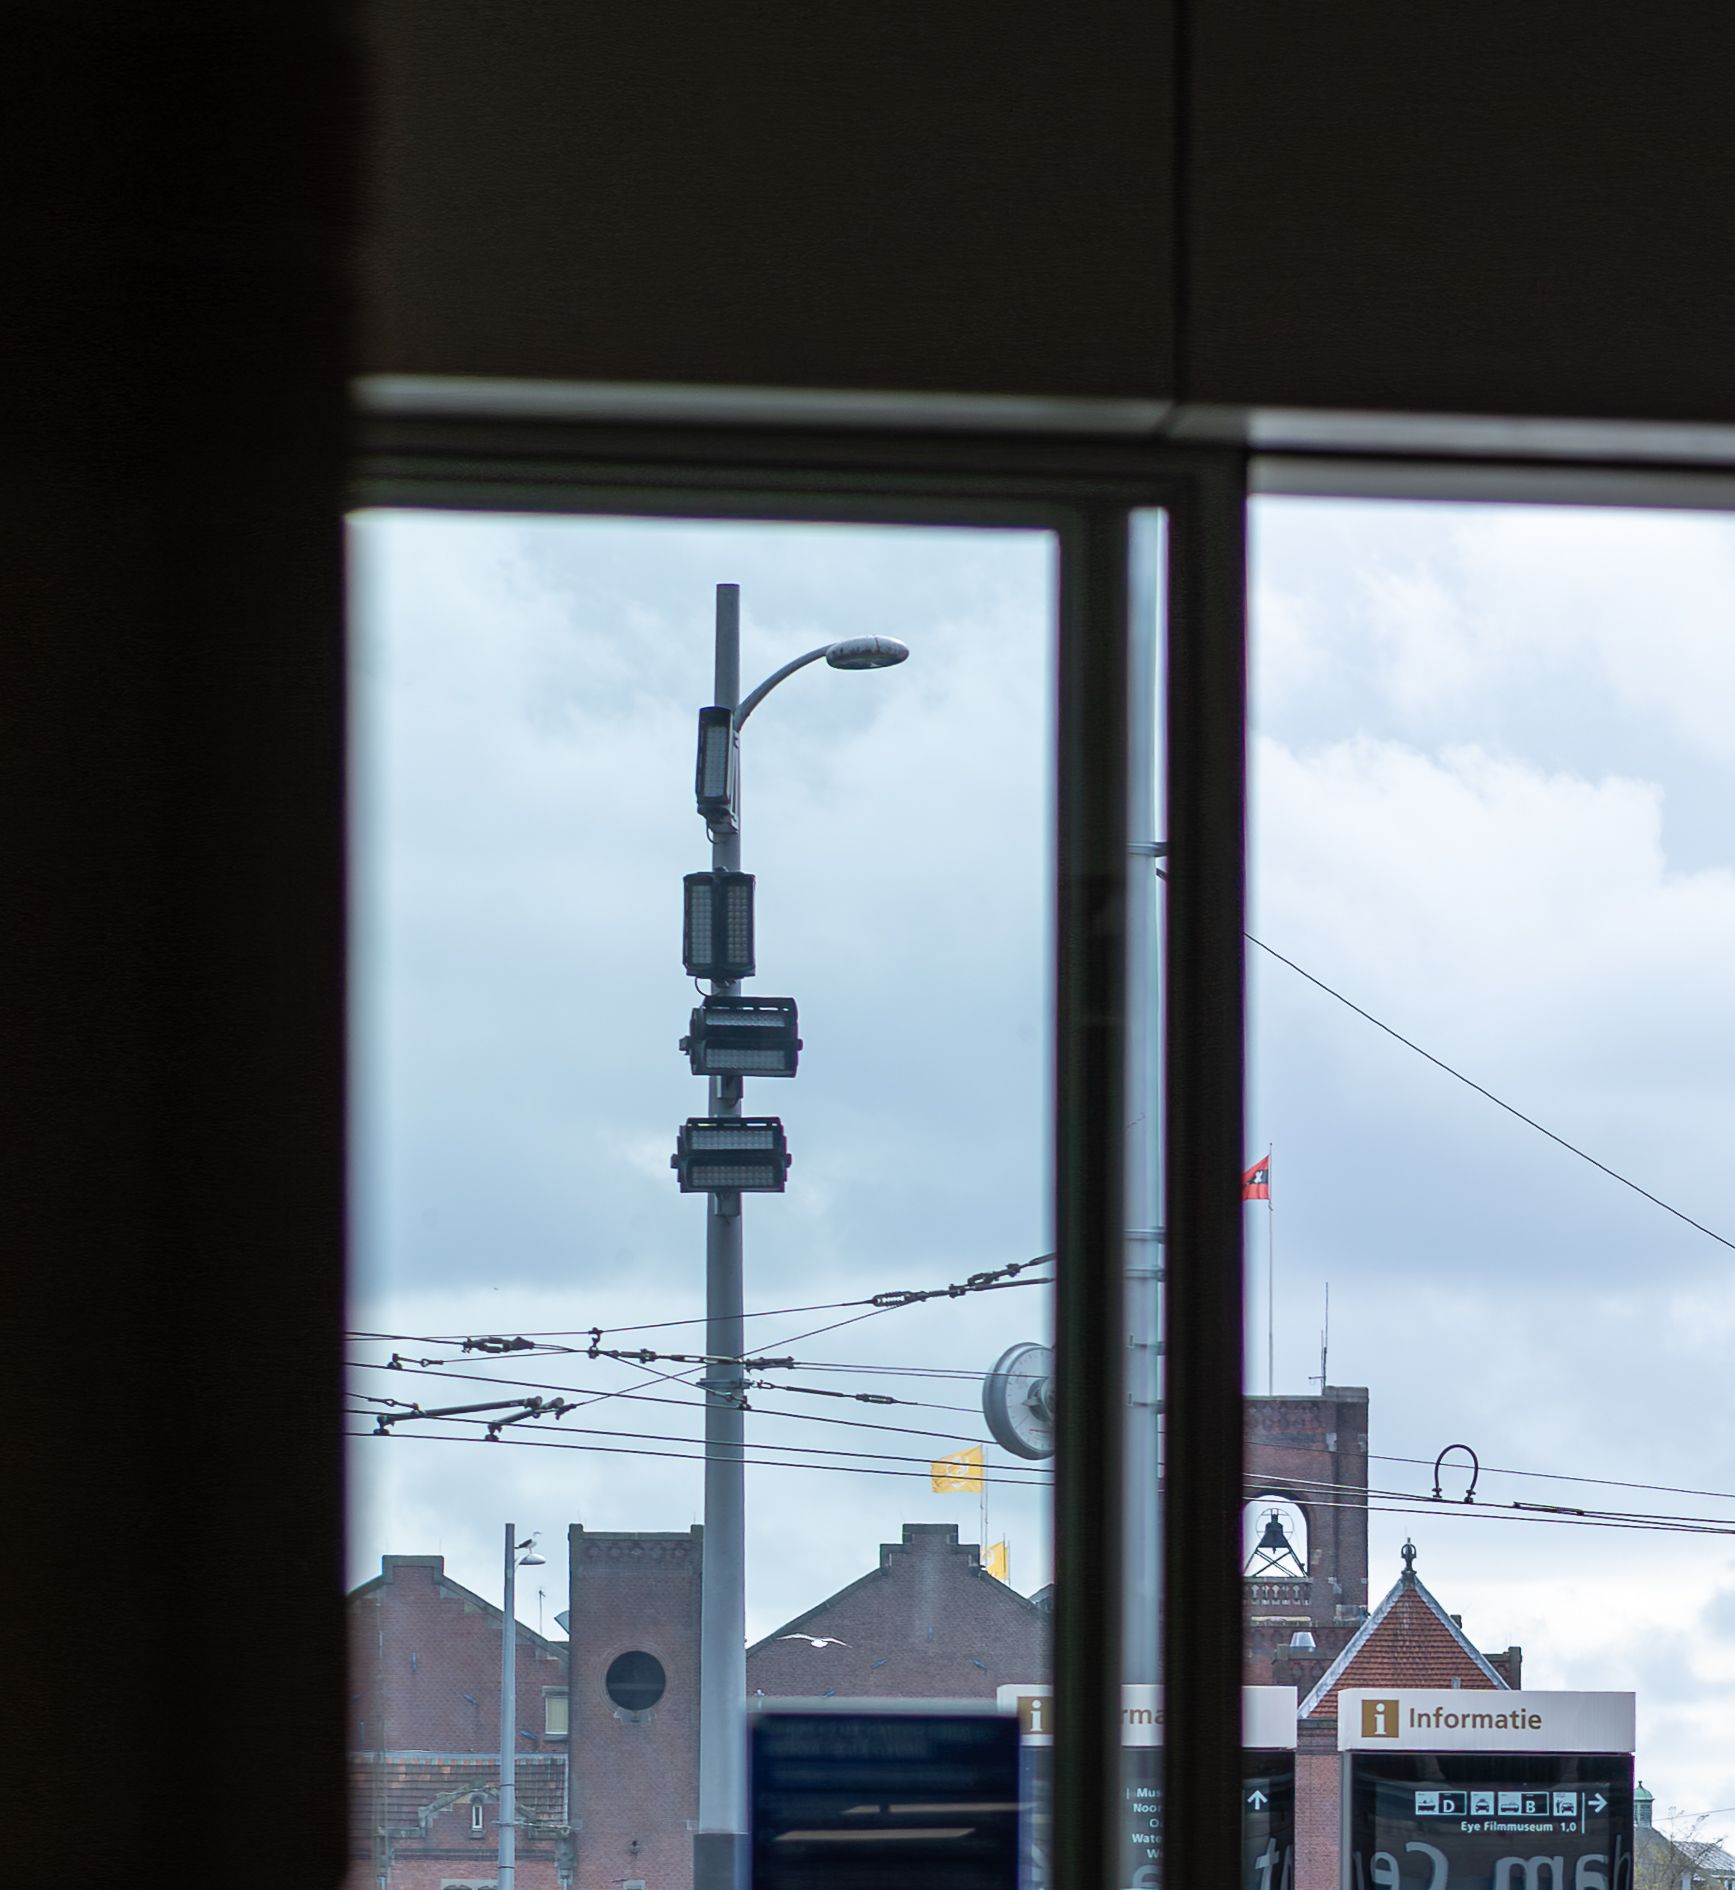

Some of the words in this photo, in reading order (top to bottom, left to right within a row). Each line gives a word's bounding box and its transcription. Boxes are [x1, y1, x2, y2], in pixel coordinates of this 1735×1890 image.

[1409, 1708, 1543, 1730] Informatie
[1443, 1801, 1455, 1813] D
[1525, 1801, 1536, 1813] B
[1461, 1821, 1481, 1832] Eye
[1484, 1821, 1553, 1832] Filmmuseum
